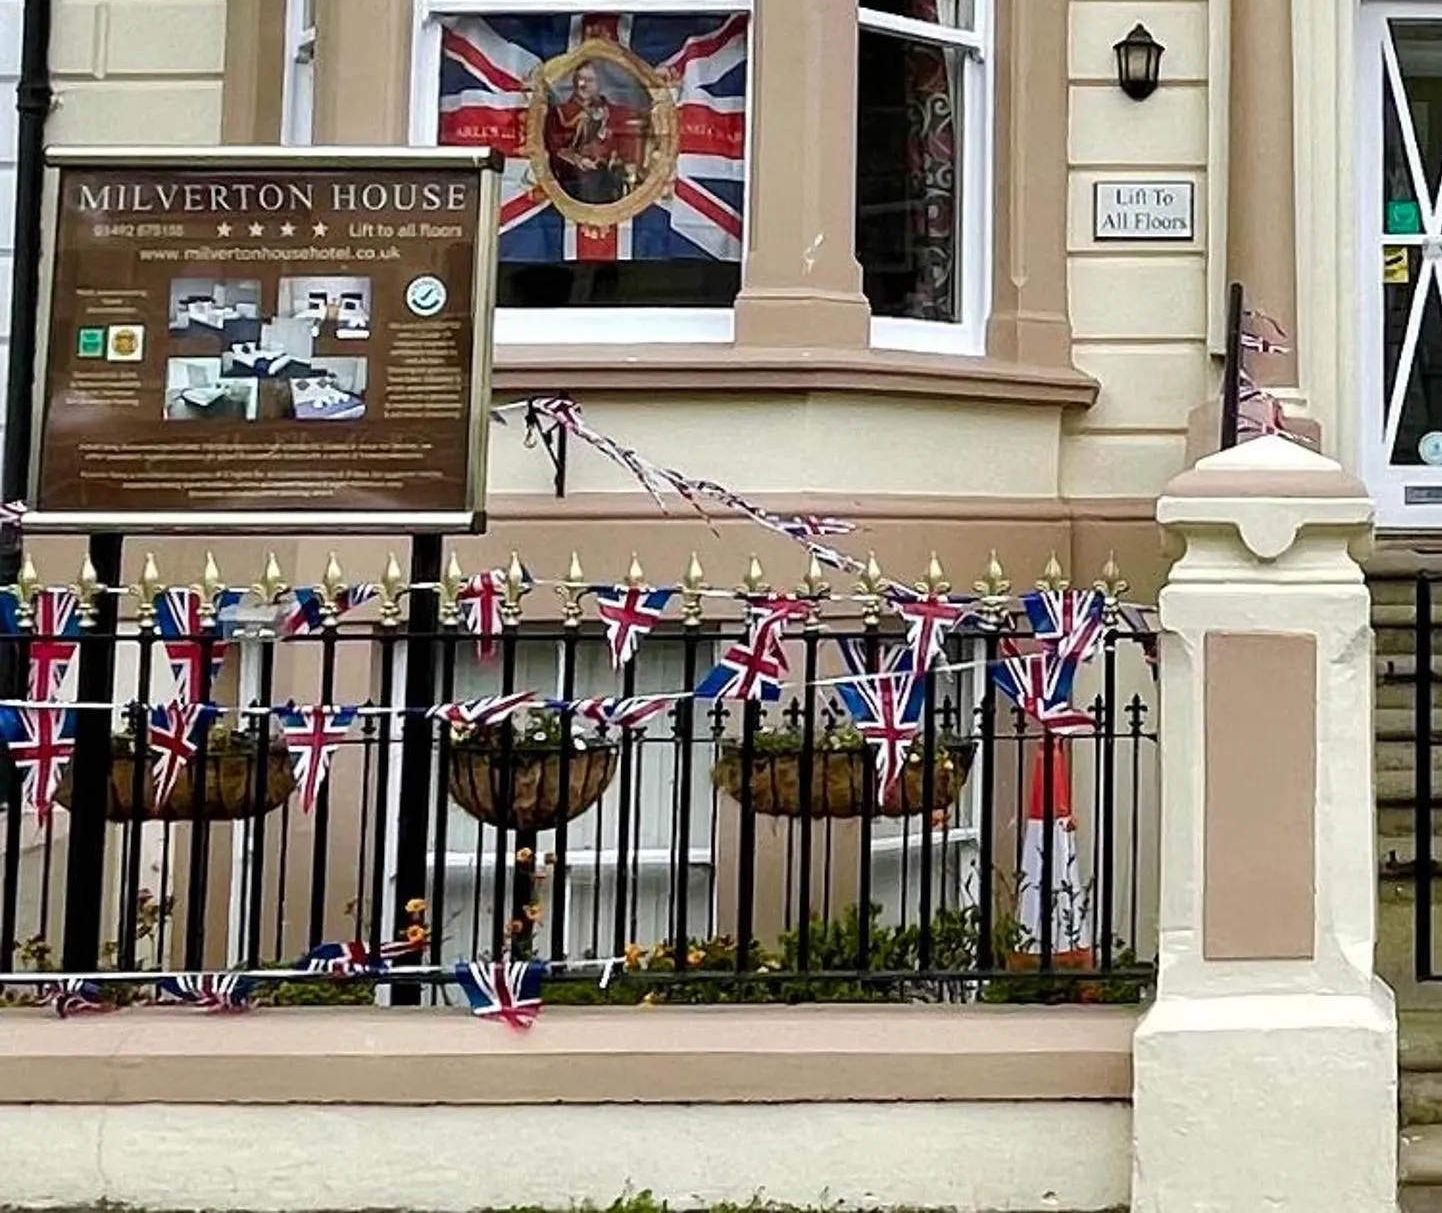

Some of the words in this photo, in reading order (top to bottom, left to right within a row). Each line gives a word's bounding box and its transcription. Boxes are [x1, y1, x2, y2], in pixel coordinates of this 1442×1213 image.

[78, 183, 313, 212] MILVERTON
[332, 183, 467, 212] HOUSE
[1116, 188, 1146, 205] Lift
[1153, 189, 1174, 206] To
[1102, 211, 1127, 229] All
[1135, 212, 1188, 230] Floors
[349, 223, 374, 238] Lift
[377, 224, 394, 238] to
[398, 223, 416, 237] all
[420, 223, 462, 237] floors
